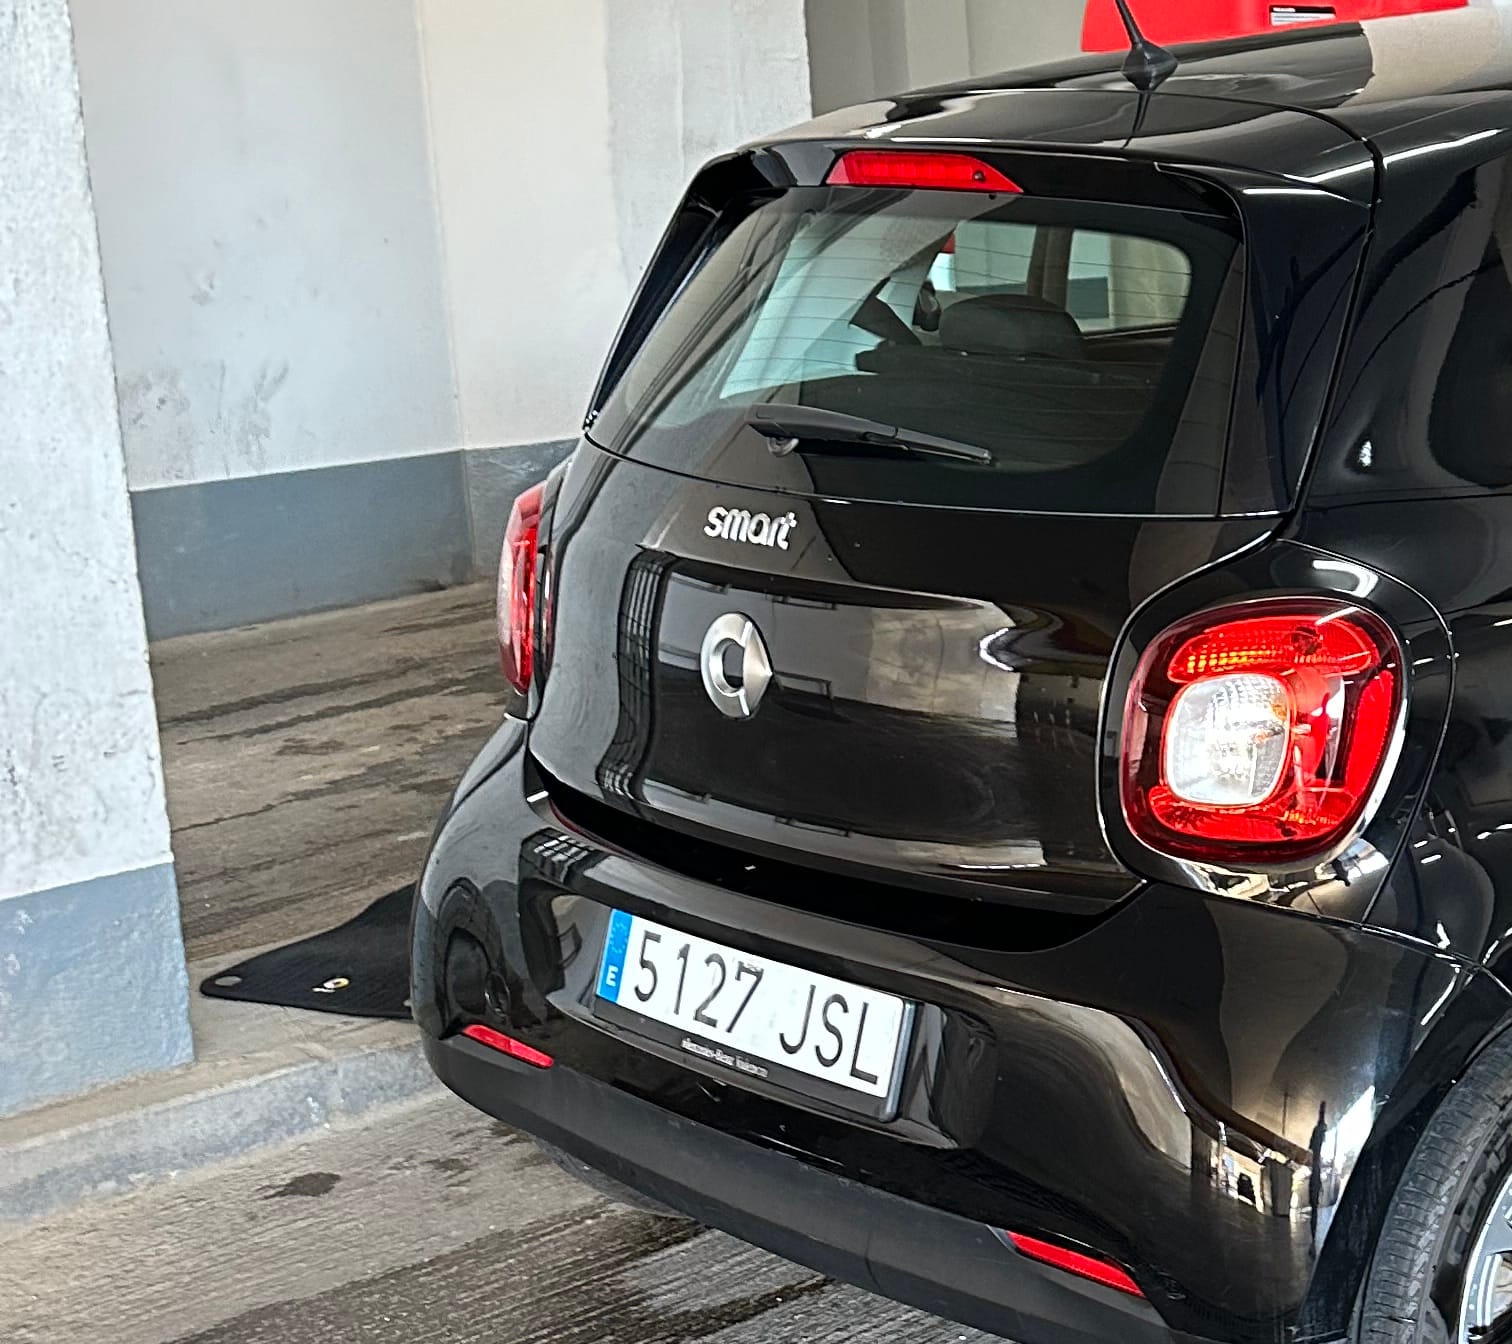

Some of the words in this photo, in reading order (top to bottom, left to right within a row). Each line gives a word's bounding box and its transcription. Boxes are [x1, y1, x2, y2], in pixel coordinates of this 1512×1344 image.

[704, 506, 797, 550] smart
[606, 965, 617, 986] E
[634, 930, 764, 1033] 5127
[779, 985, 878, 1085] JSL
